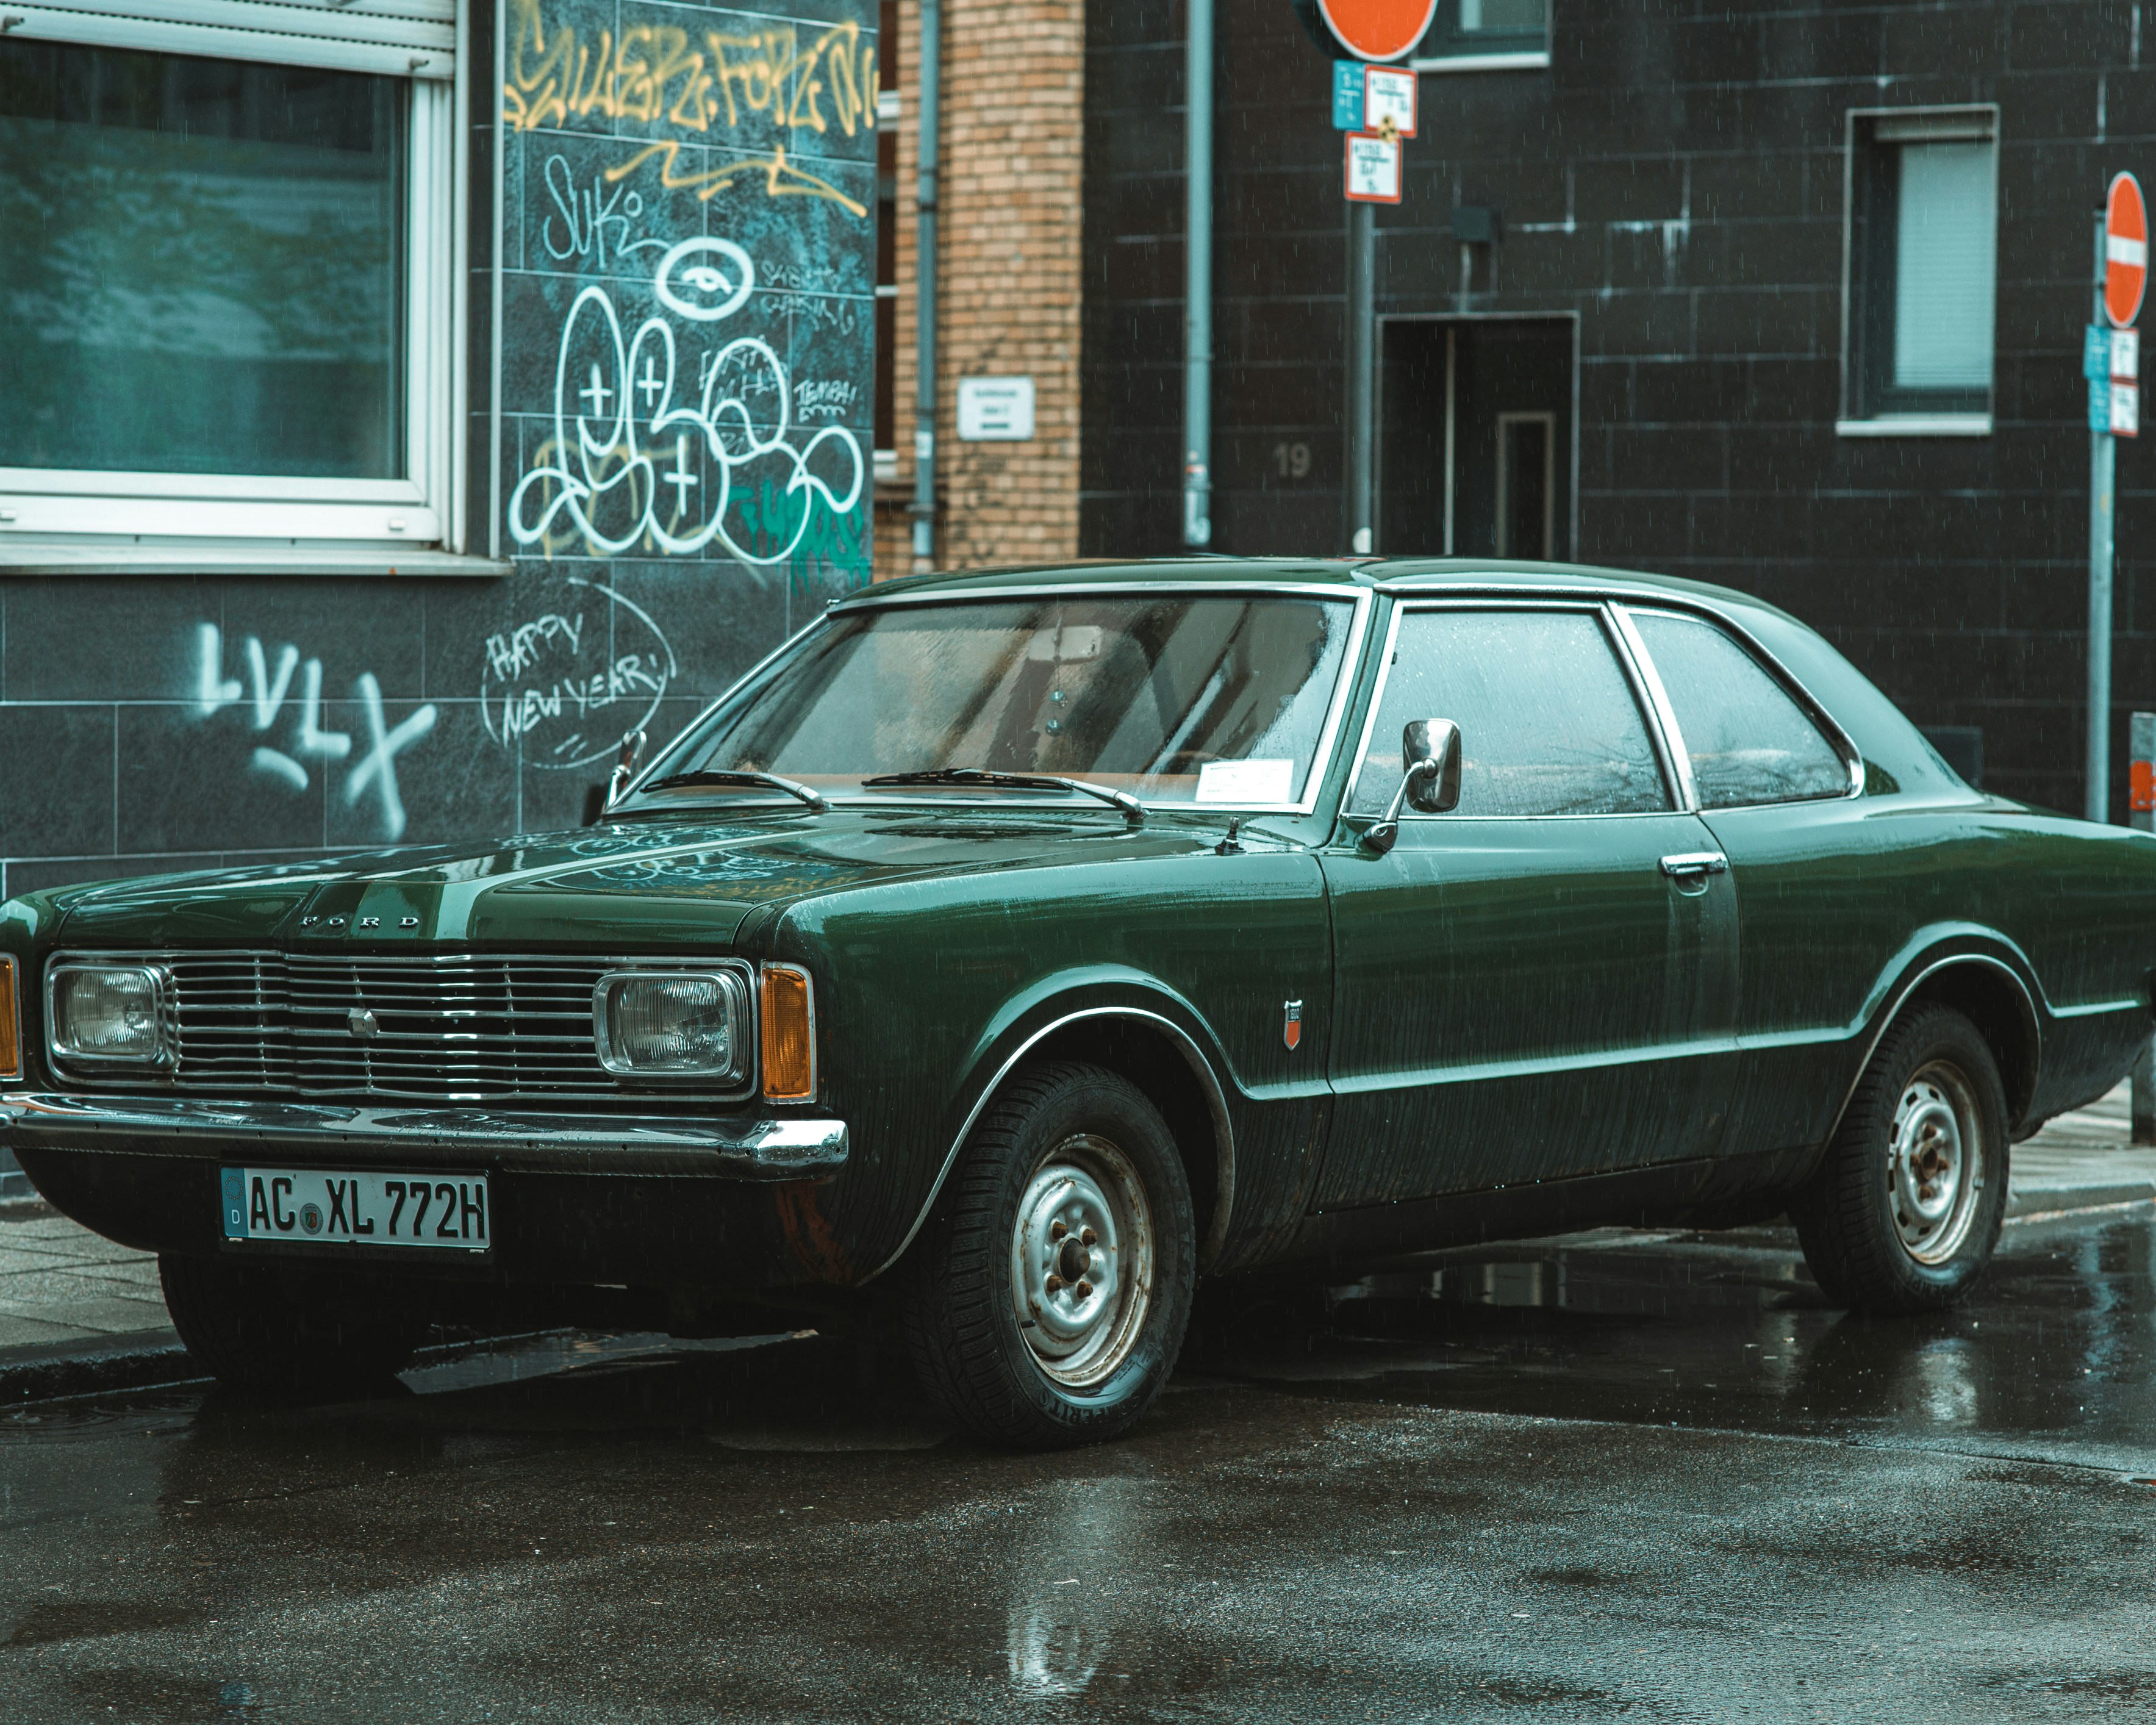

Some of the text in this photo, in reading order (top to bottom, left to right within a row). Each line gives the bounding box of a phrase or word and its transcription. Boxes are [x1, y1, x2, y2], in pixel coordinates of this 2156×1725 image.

[1273, 442, 1311, 478] 19
[485, 612, 584, 683] HAPPY
[503, 683, 562, 749] NEW
[300, 916, 419, 928] FORD
[231, 1209, 240, 1225] D
[249, 1176, 296, 1232] AC
[325, 1178, 374, 1235] XL
[385, 1181, 485, 1239] 772H
